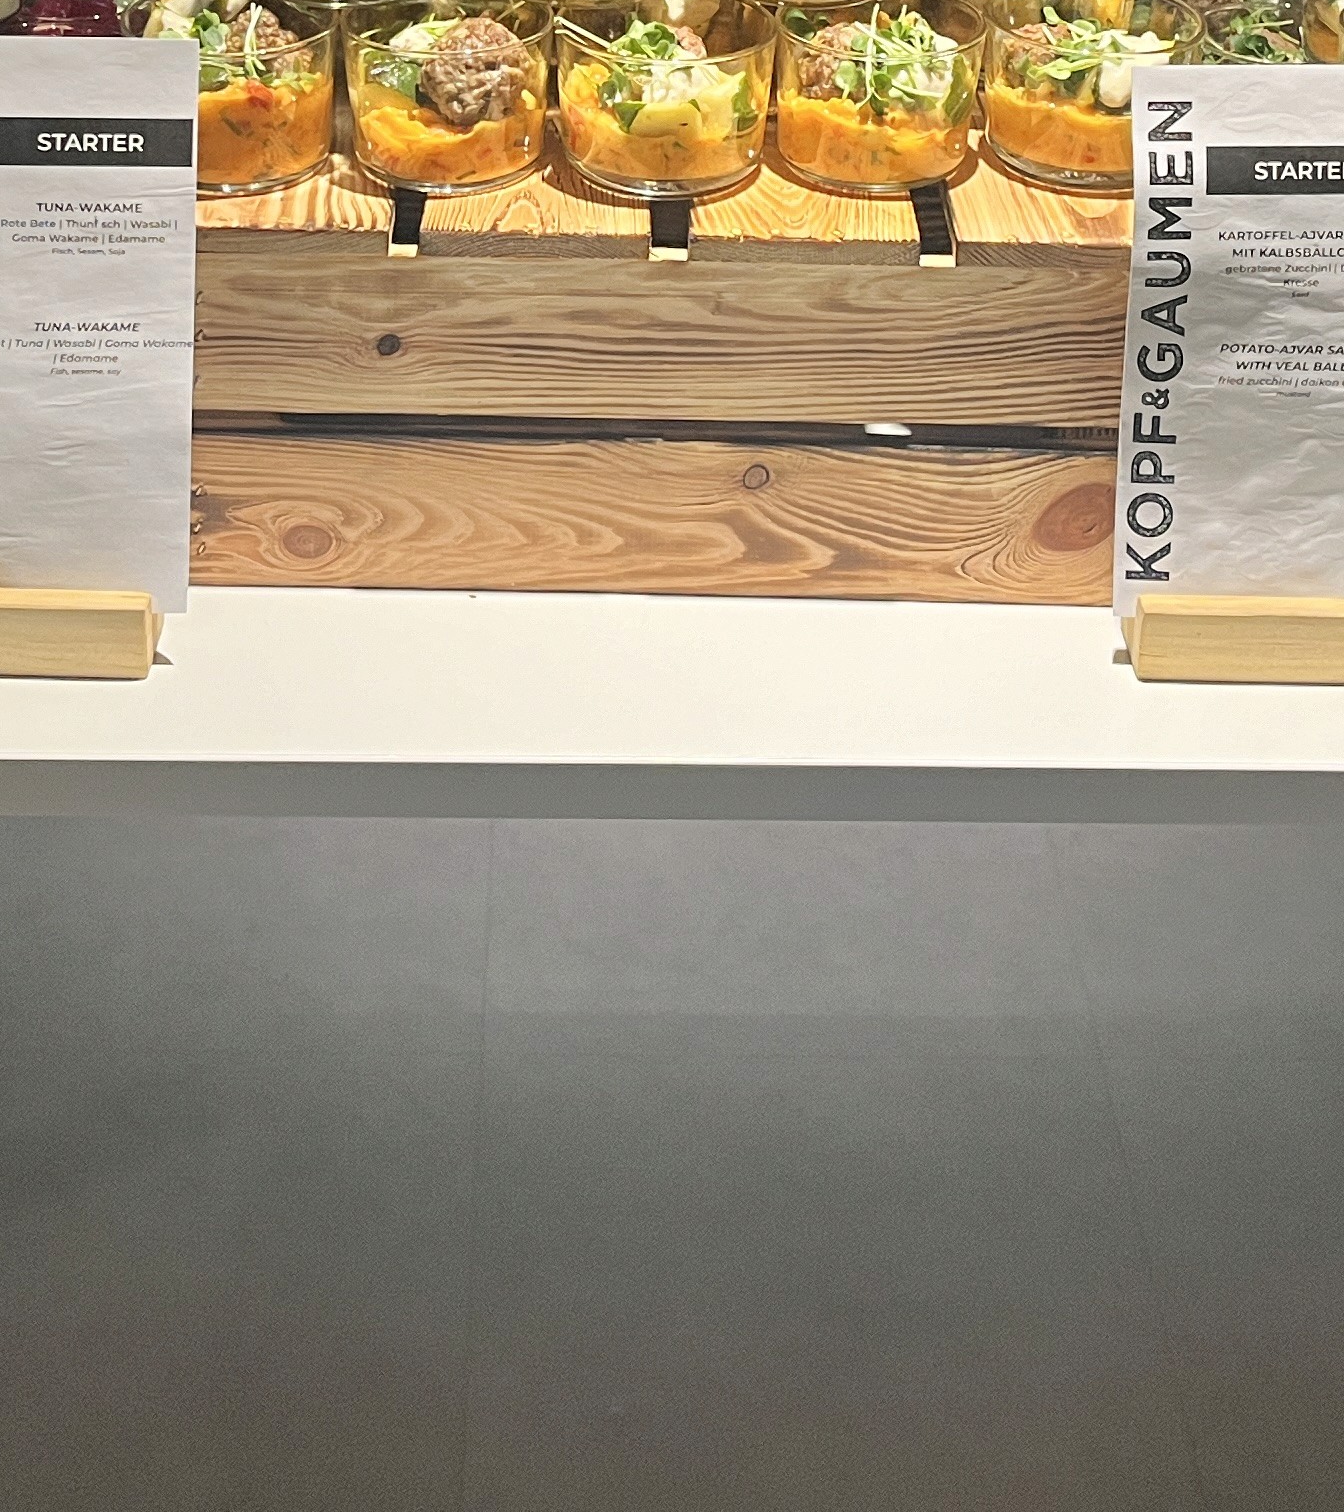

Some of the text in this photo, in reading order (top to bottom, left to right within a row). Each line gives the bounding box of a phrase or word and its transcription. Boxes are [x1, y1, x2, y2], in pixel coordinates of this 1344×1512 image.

[36, 132, 145, 154] STARTER
[36, 202, 143, 214] TUNA-WAKAME
[0, 219, 27, 228] Rote
[30, 219, 56, 228] Bete
[129, 219, 172, 228] Wasabi
[49, 234, 99, 243] Wakame
[108, 234, 166, 243] Edamame
[1218, 230, 1344, 240] KARTOFFEL-AJVAR
[1232, 248, 1256, 257] MIT
[1285, 263, 1332, 273] Zucchini
[34, 322, 141, 333] TUNA-WAKAME
[15, 339, 44, 348] Tuna
[53, 339, 96, 348] Wasabi
[143, 339, 194, 348] Wakame
[1125, 99, 1194, 581] KOPF&GAUMEN
[1219, 343, 1324, 355] POTATO-AJVAR
[59, 353, 119, 363] Edamame
[1235, 361, 1271, 371] WITH
[1276, 361, 1309, 371] VEAL
[1218, 376, 1244, 385] fried
[1247, 377, 1293, 386] zucchini
[1300, 378, 1340, 387] daikon
